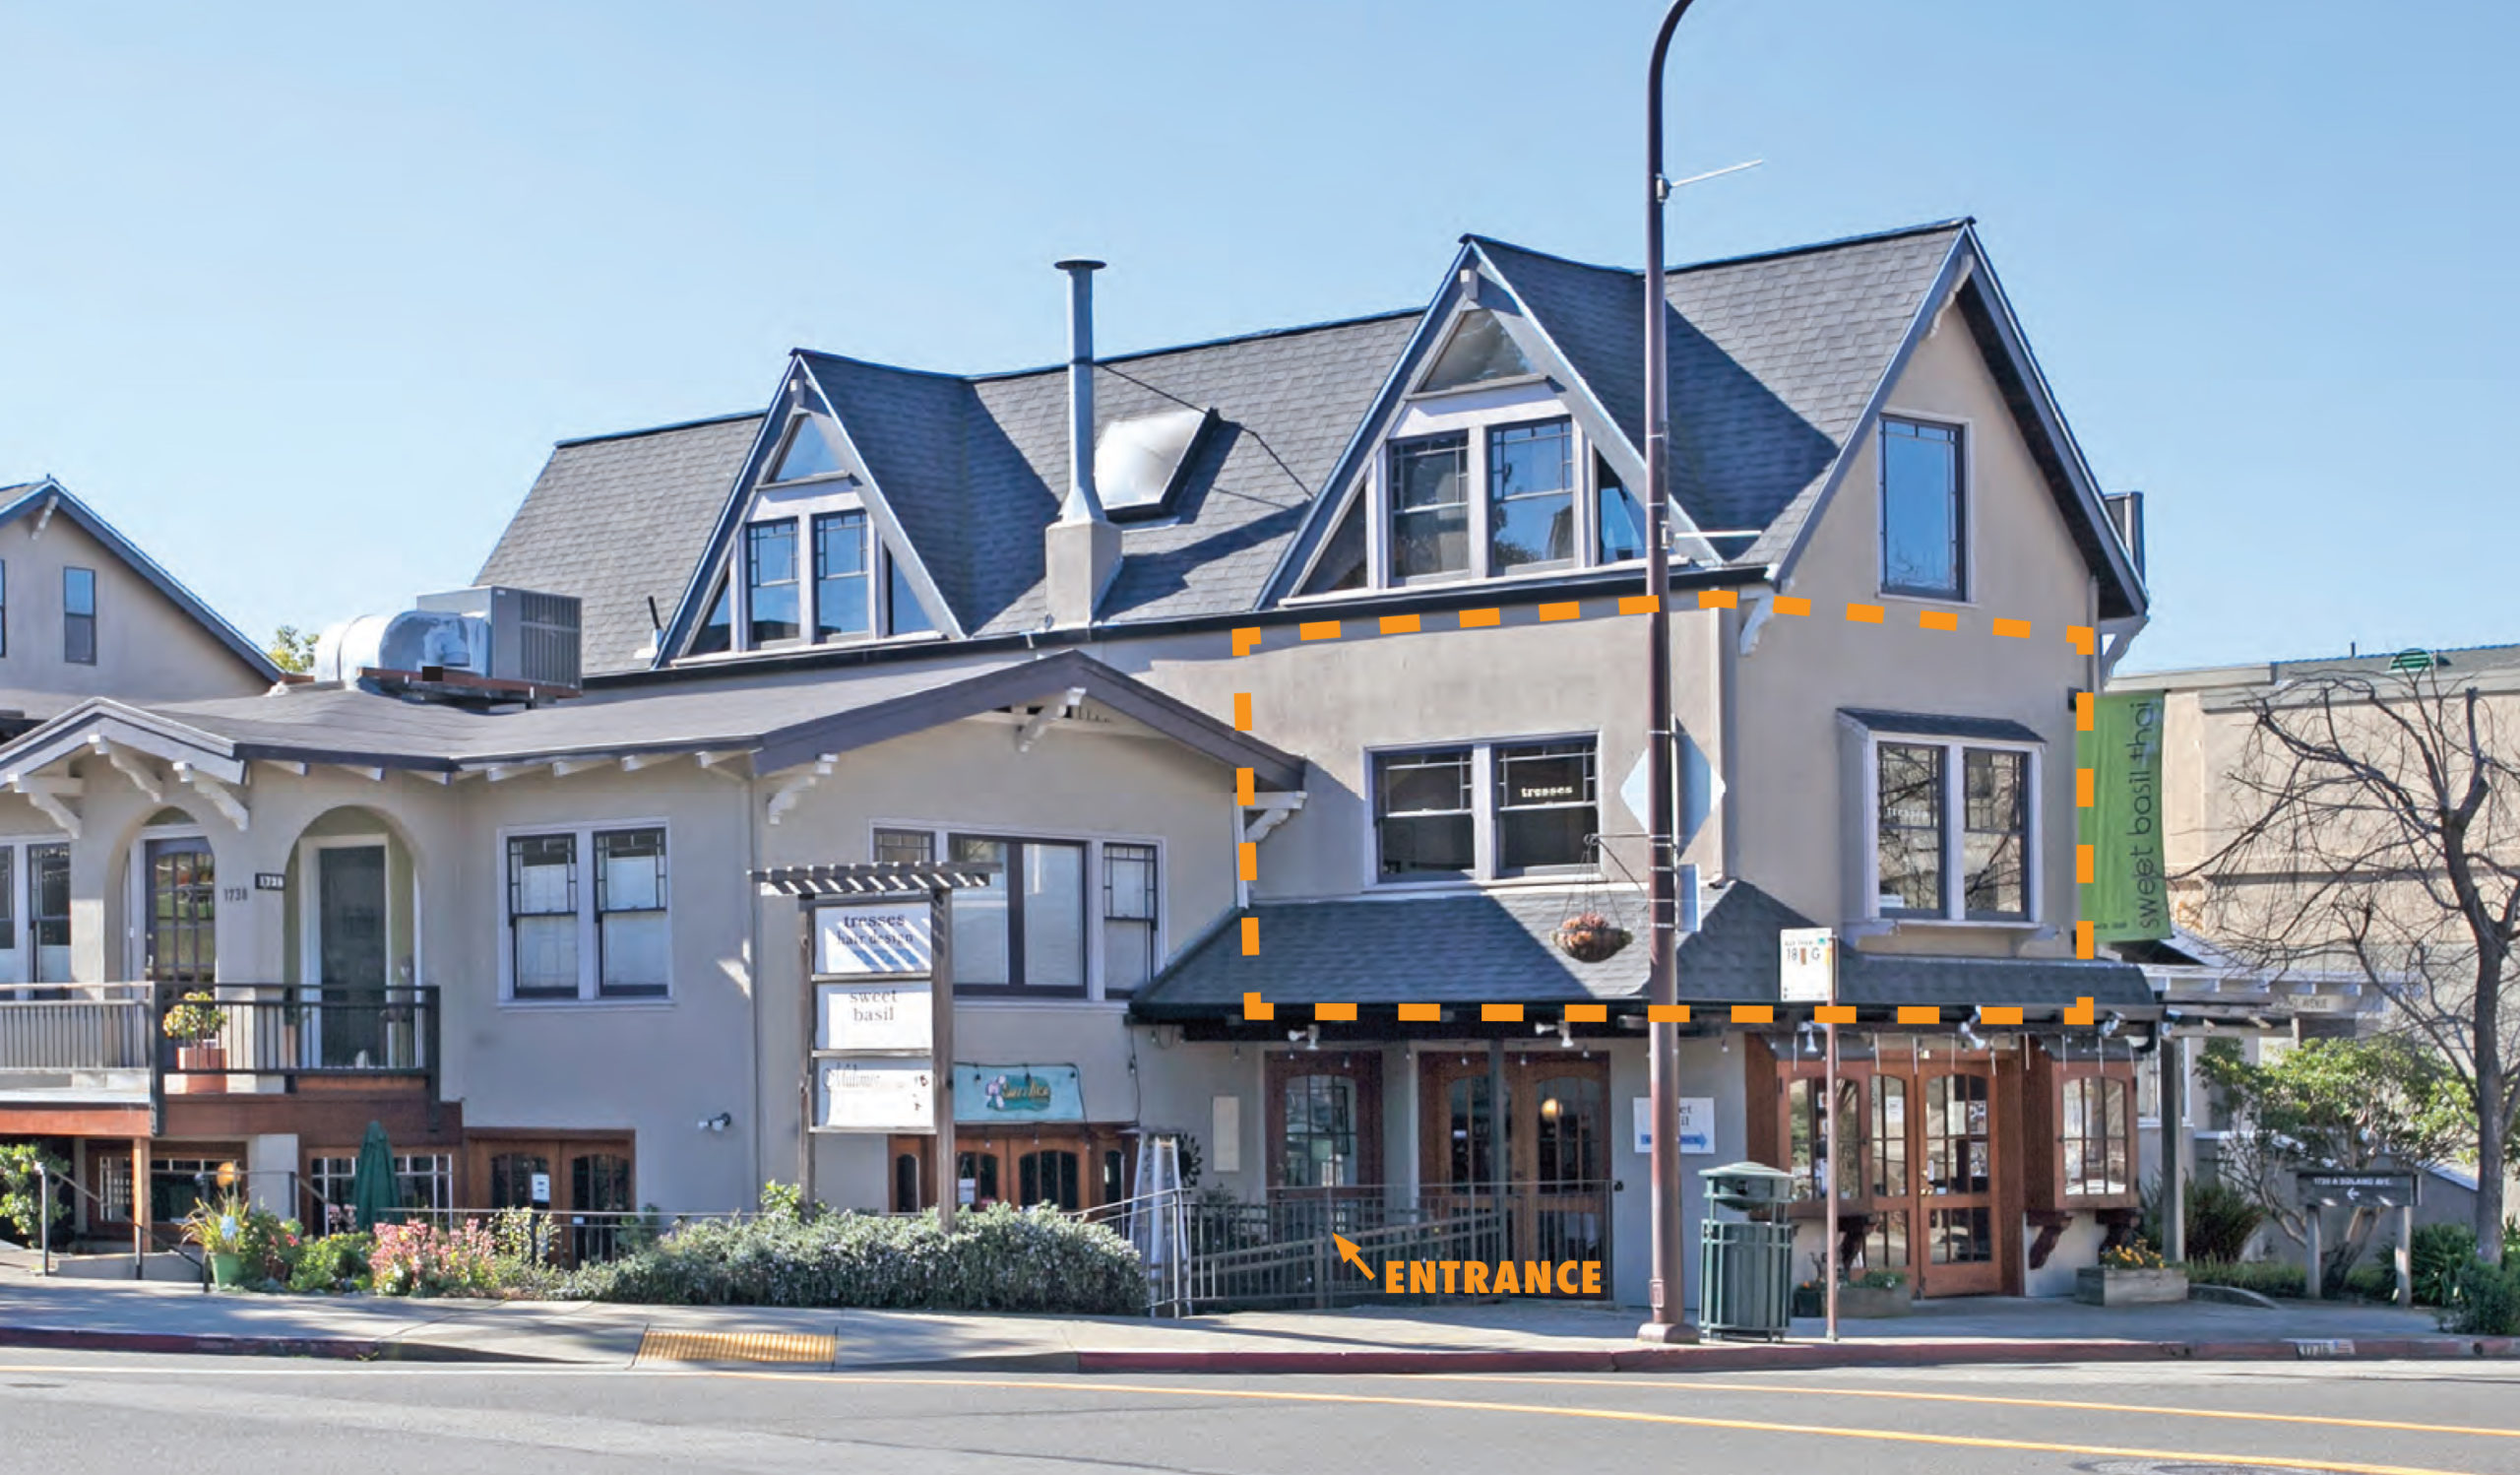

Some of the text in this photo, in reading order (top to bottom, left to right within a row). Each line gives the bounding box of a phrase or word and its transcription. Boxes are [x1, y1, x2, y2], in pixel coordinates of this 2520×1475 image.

[1521, 786, 1574, 798] tresses
[2126, 701, 2160, 929] sweet basil thai
[844, 914, 906, 928] tresses
[850, 989, 898, 1003] sweet
[853, 1006, 895, 1022] basil
